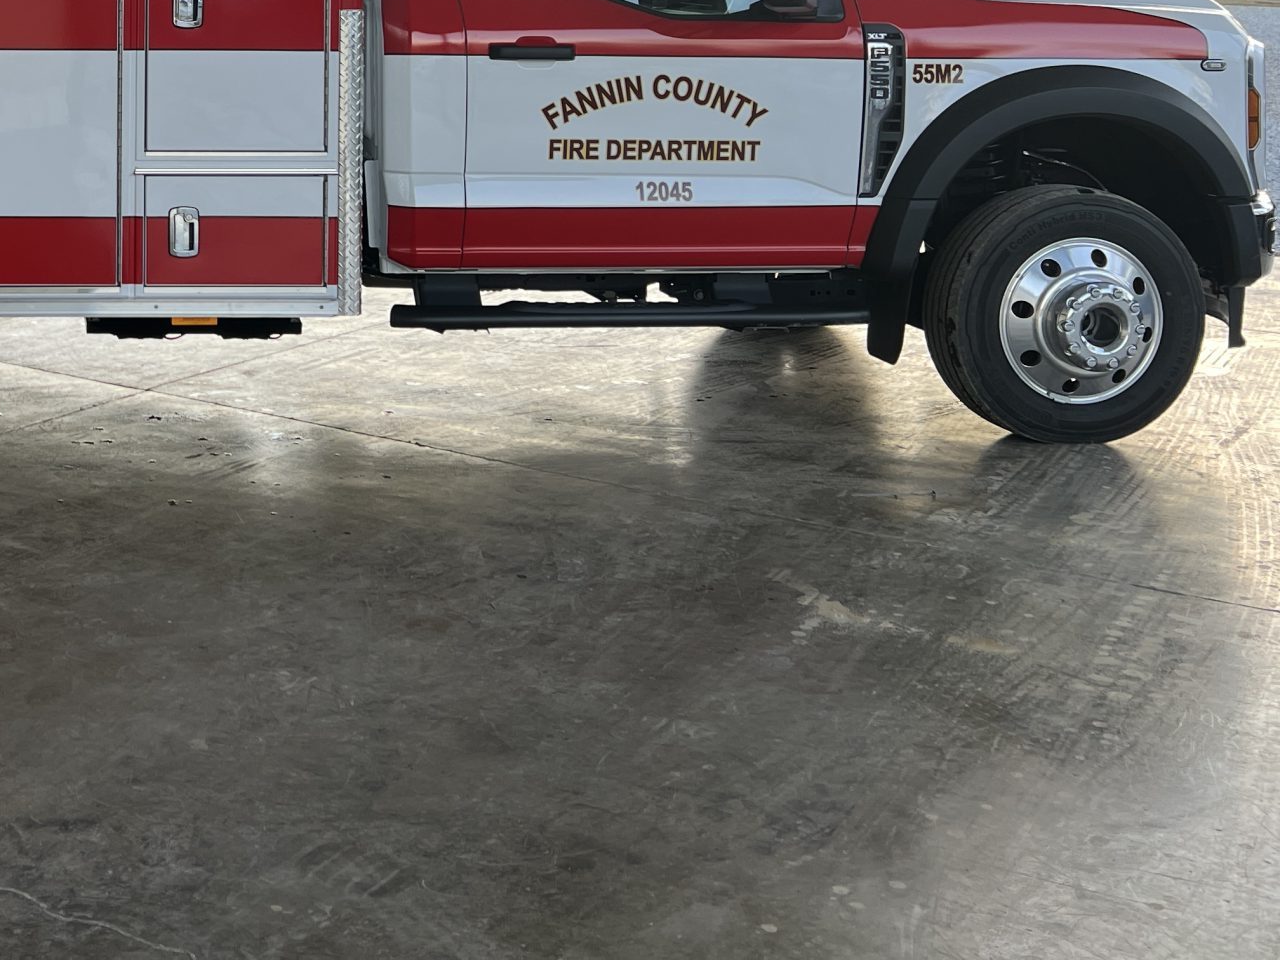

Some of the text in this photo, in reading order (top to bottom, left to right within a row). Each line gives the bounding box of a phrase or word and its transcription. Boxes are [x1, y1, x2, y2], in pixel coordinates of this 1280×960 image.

[867, 32, 888, 40] XLT
[912, 63, 964, 84] 55M2
[541, 74, 769, 130] FANNIN COUNTY
[548, 139, 761, 162] FIRE DEPARTMENT
[635, 181, 693, 202] 12045
